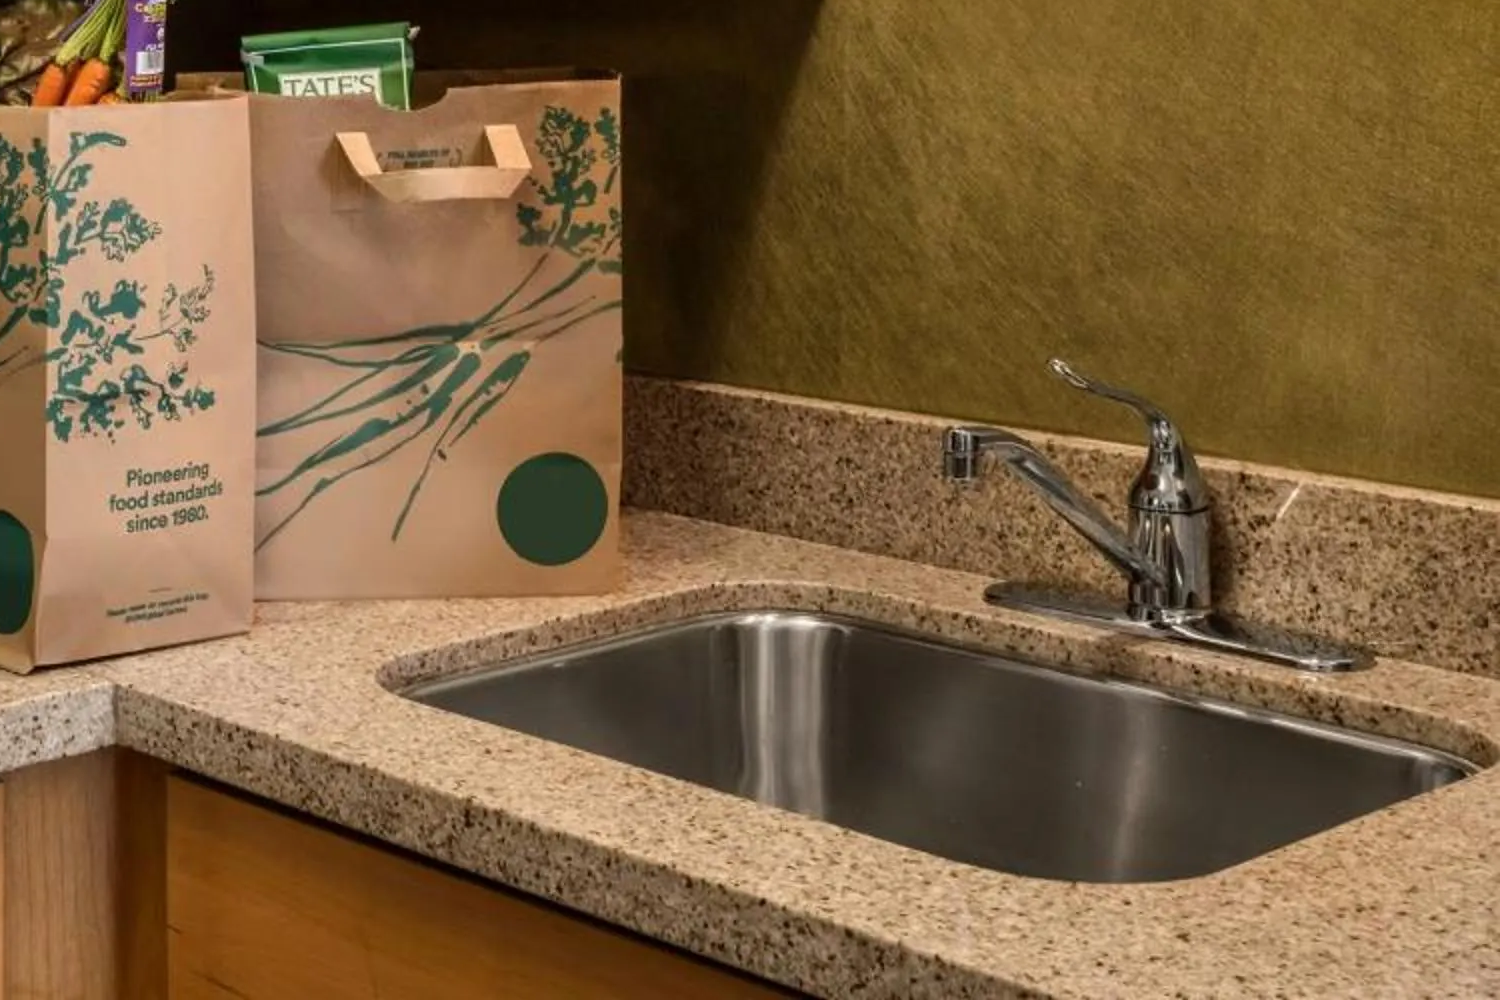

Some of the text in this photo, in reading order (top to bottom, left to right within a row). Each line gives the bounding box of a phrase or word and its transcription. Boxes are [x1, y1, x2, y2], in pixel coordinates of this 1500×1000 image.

[284, 73, 375, 97] TATE'S
[126, 461, 210, 488] Pioneering
[109, 479, 224, 512] food standards
[126, 503, 209, 533] since 1980.
